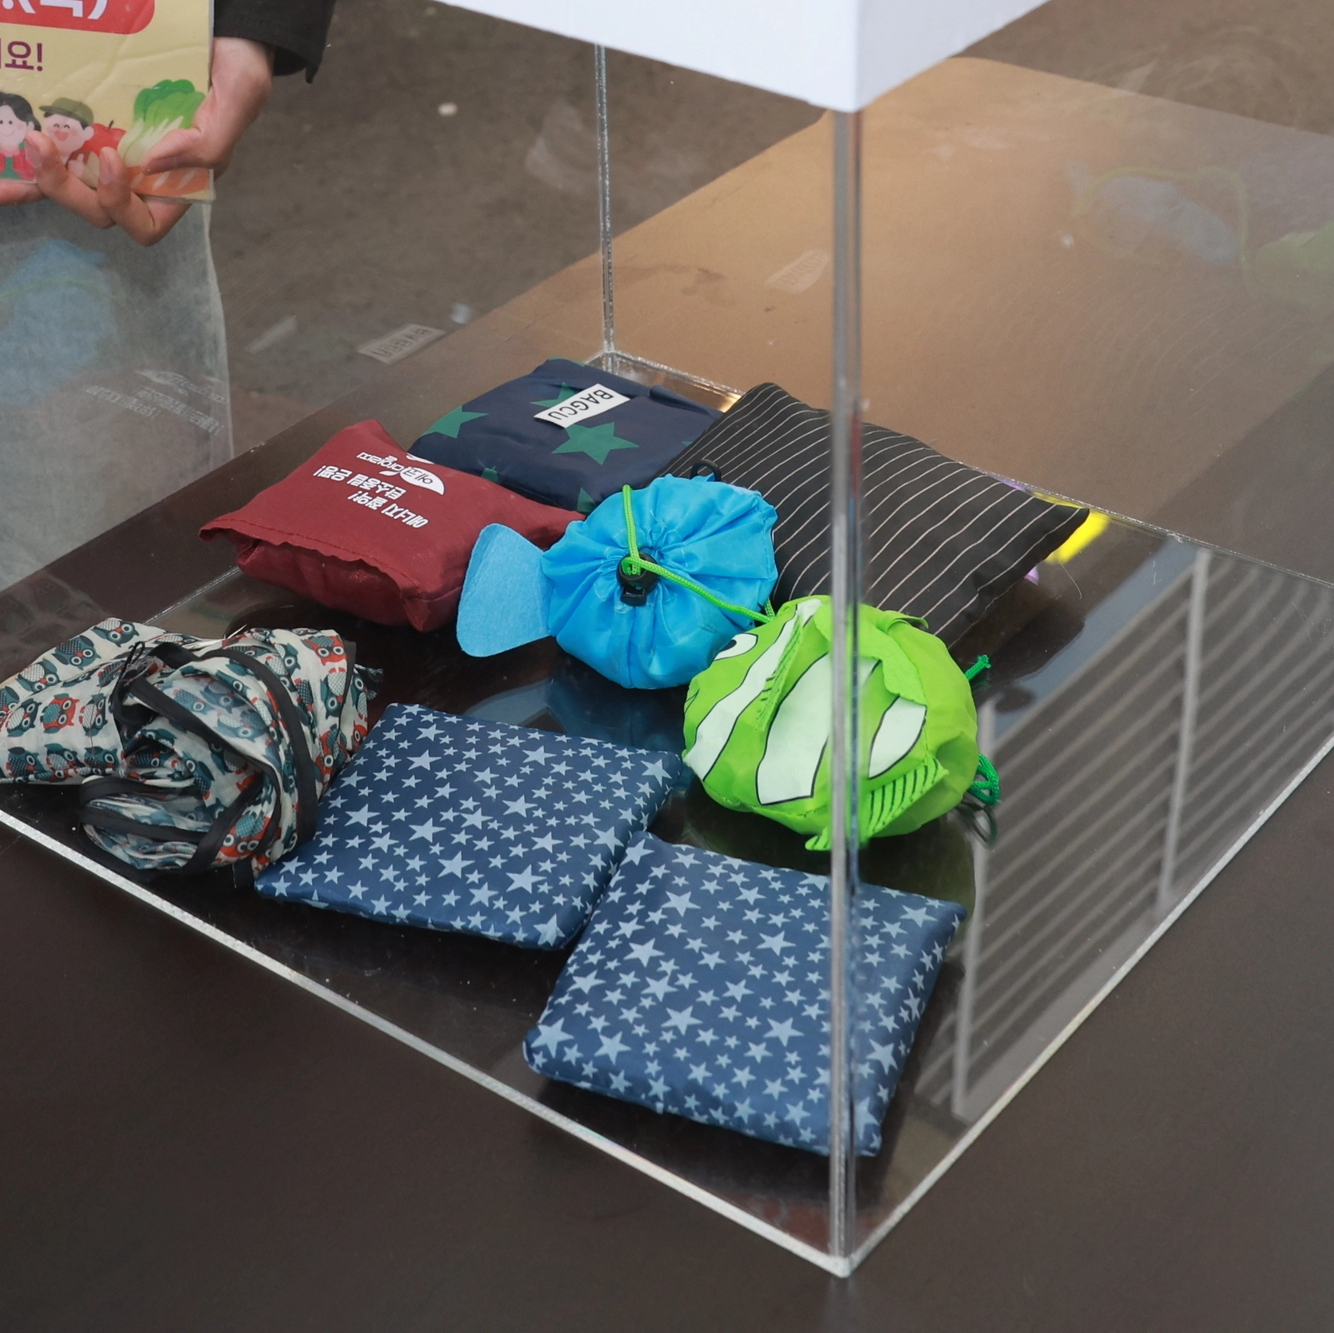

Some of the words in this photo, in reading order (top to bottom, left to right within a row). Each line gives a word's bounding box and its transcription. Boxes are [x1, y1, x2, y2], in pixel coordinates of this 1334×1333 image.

[547, 389, 614, 420] BAGCU
[313, 465, 353, 482] 은평!
[346, 473, 407, 500] 탄소중립
[347, 490, 389, 510] 절약!
[380, 503, 429, 528] 에너지
